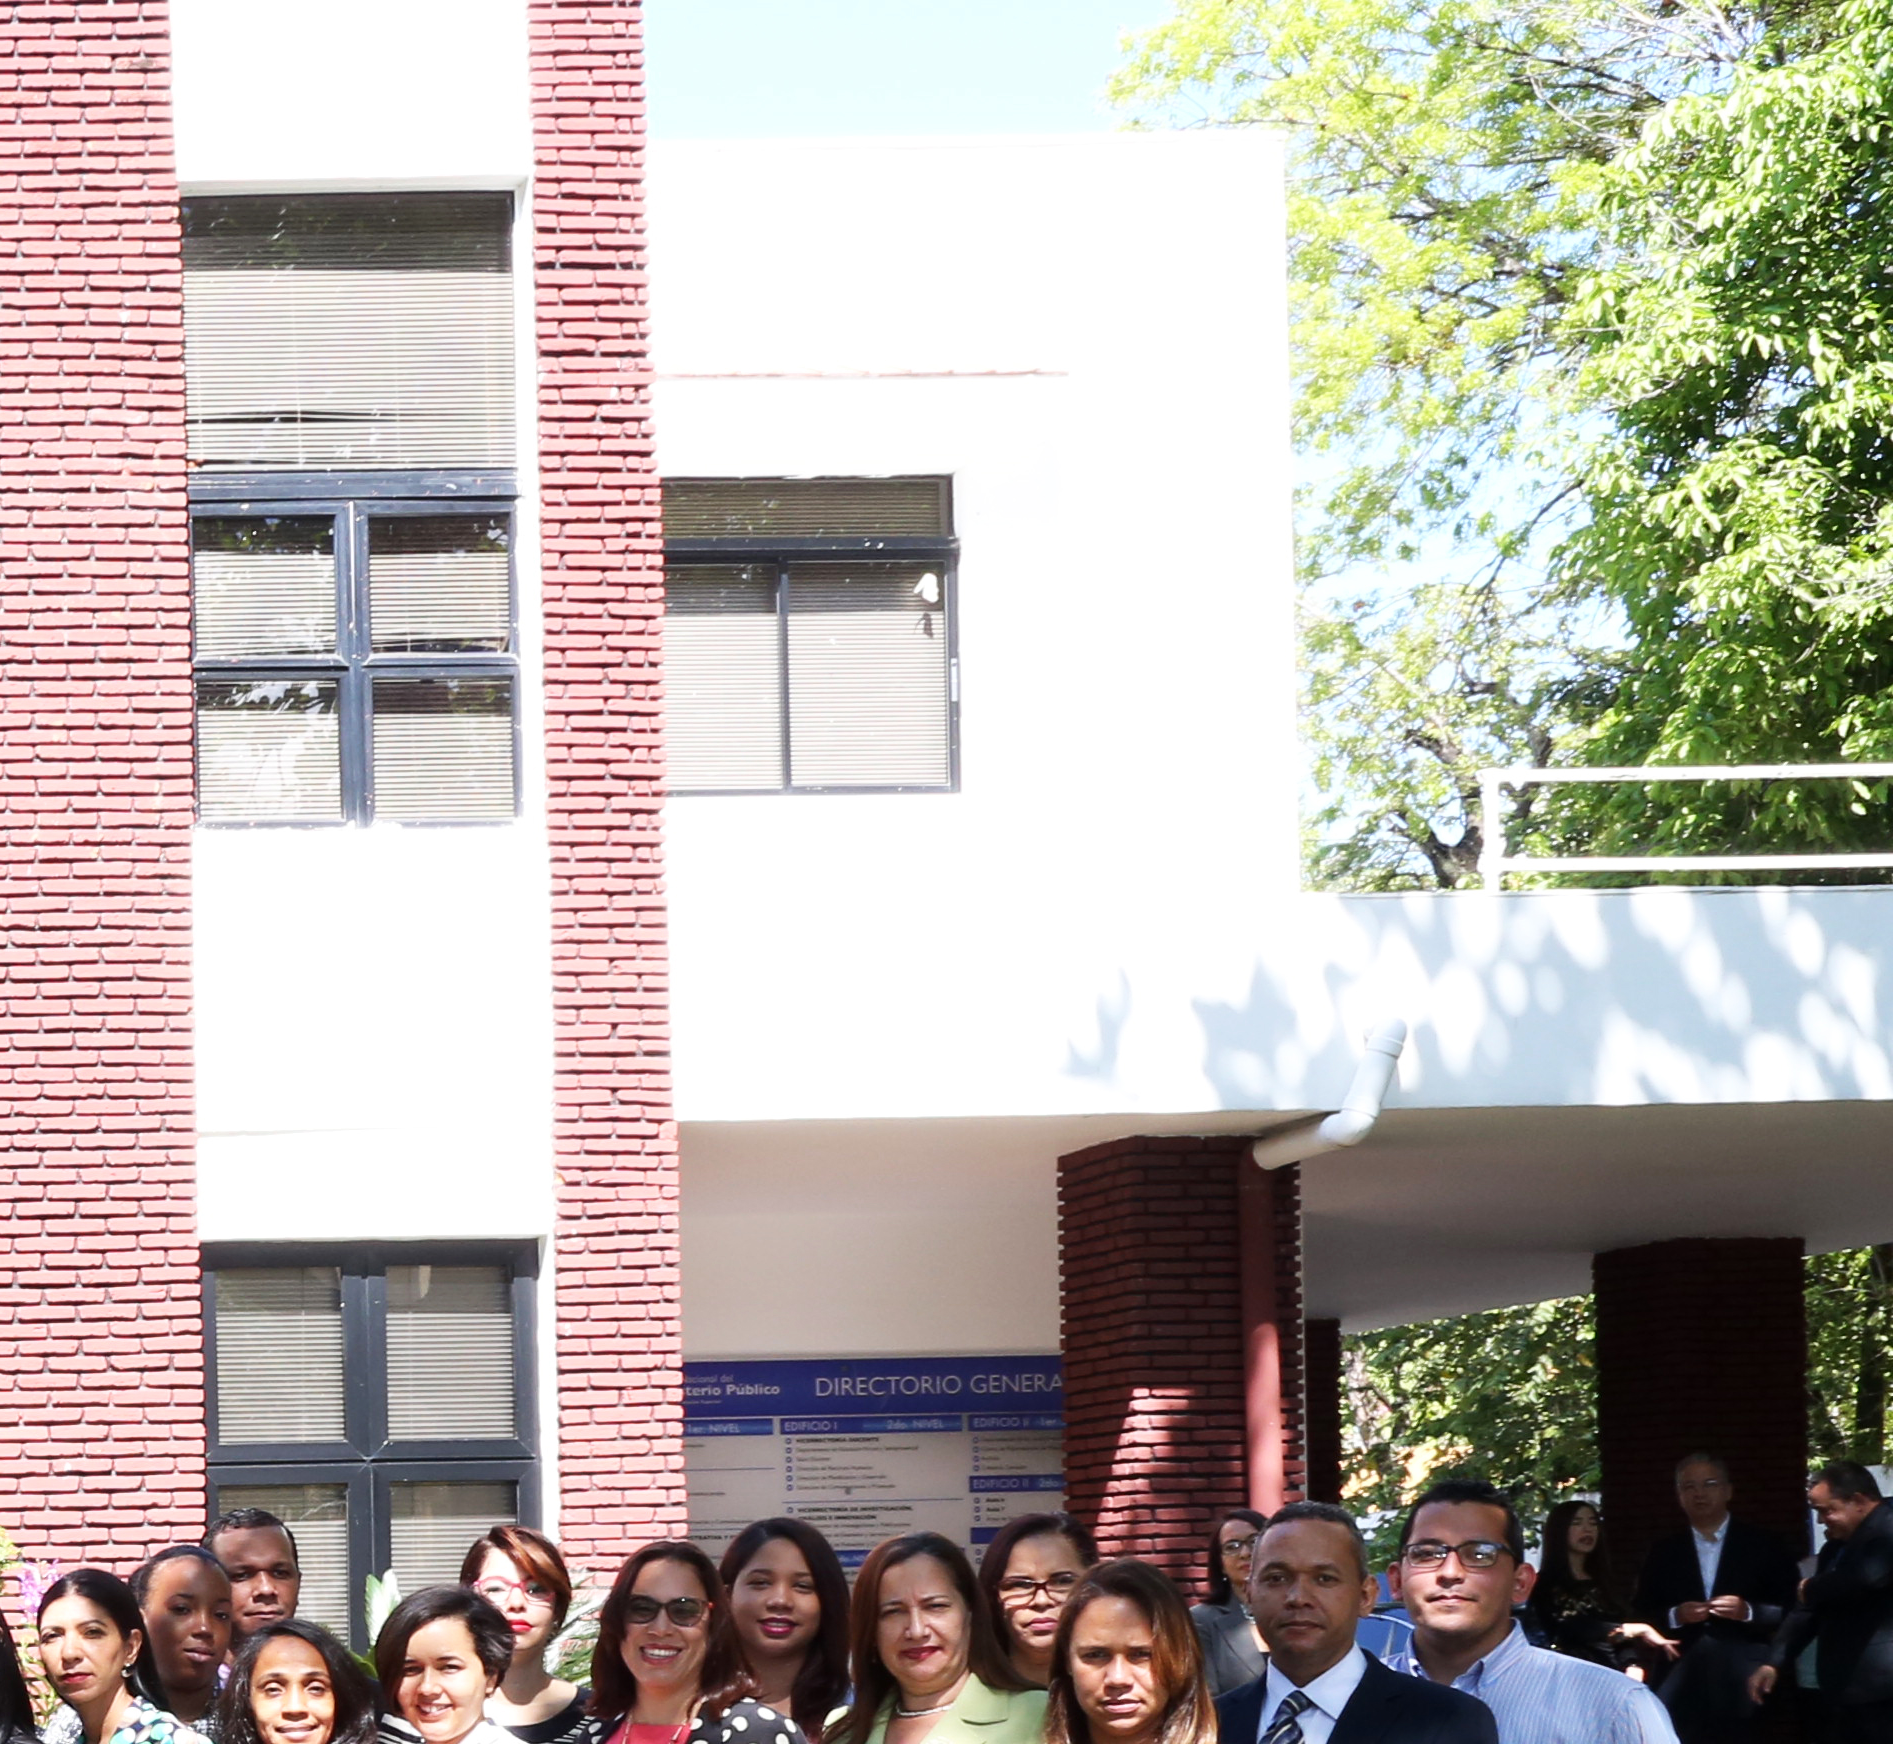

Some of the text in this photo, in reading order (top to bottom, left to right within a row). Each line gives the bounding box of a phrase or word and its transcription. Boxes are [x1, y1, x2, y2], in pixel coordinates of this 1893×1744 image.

[684, 1383, 780, 1397] terio Público
[815, 1373, 1062, 1397] DIRECTORIO GENERA
[784, 1421, 831, 1431] EDIFICIO
[912, 1419, 945, 1429] NIVEL
[973, 1417, 1020, 1428] EDIFICIO
[708, 1423, 741, 1434] NIVEL
[973, 1478, 1020, 1489] EDIFICIO
